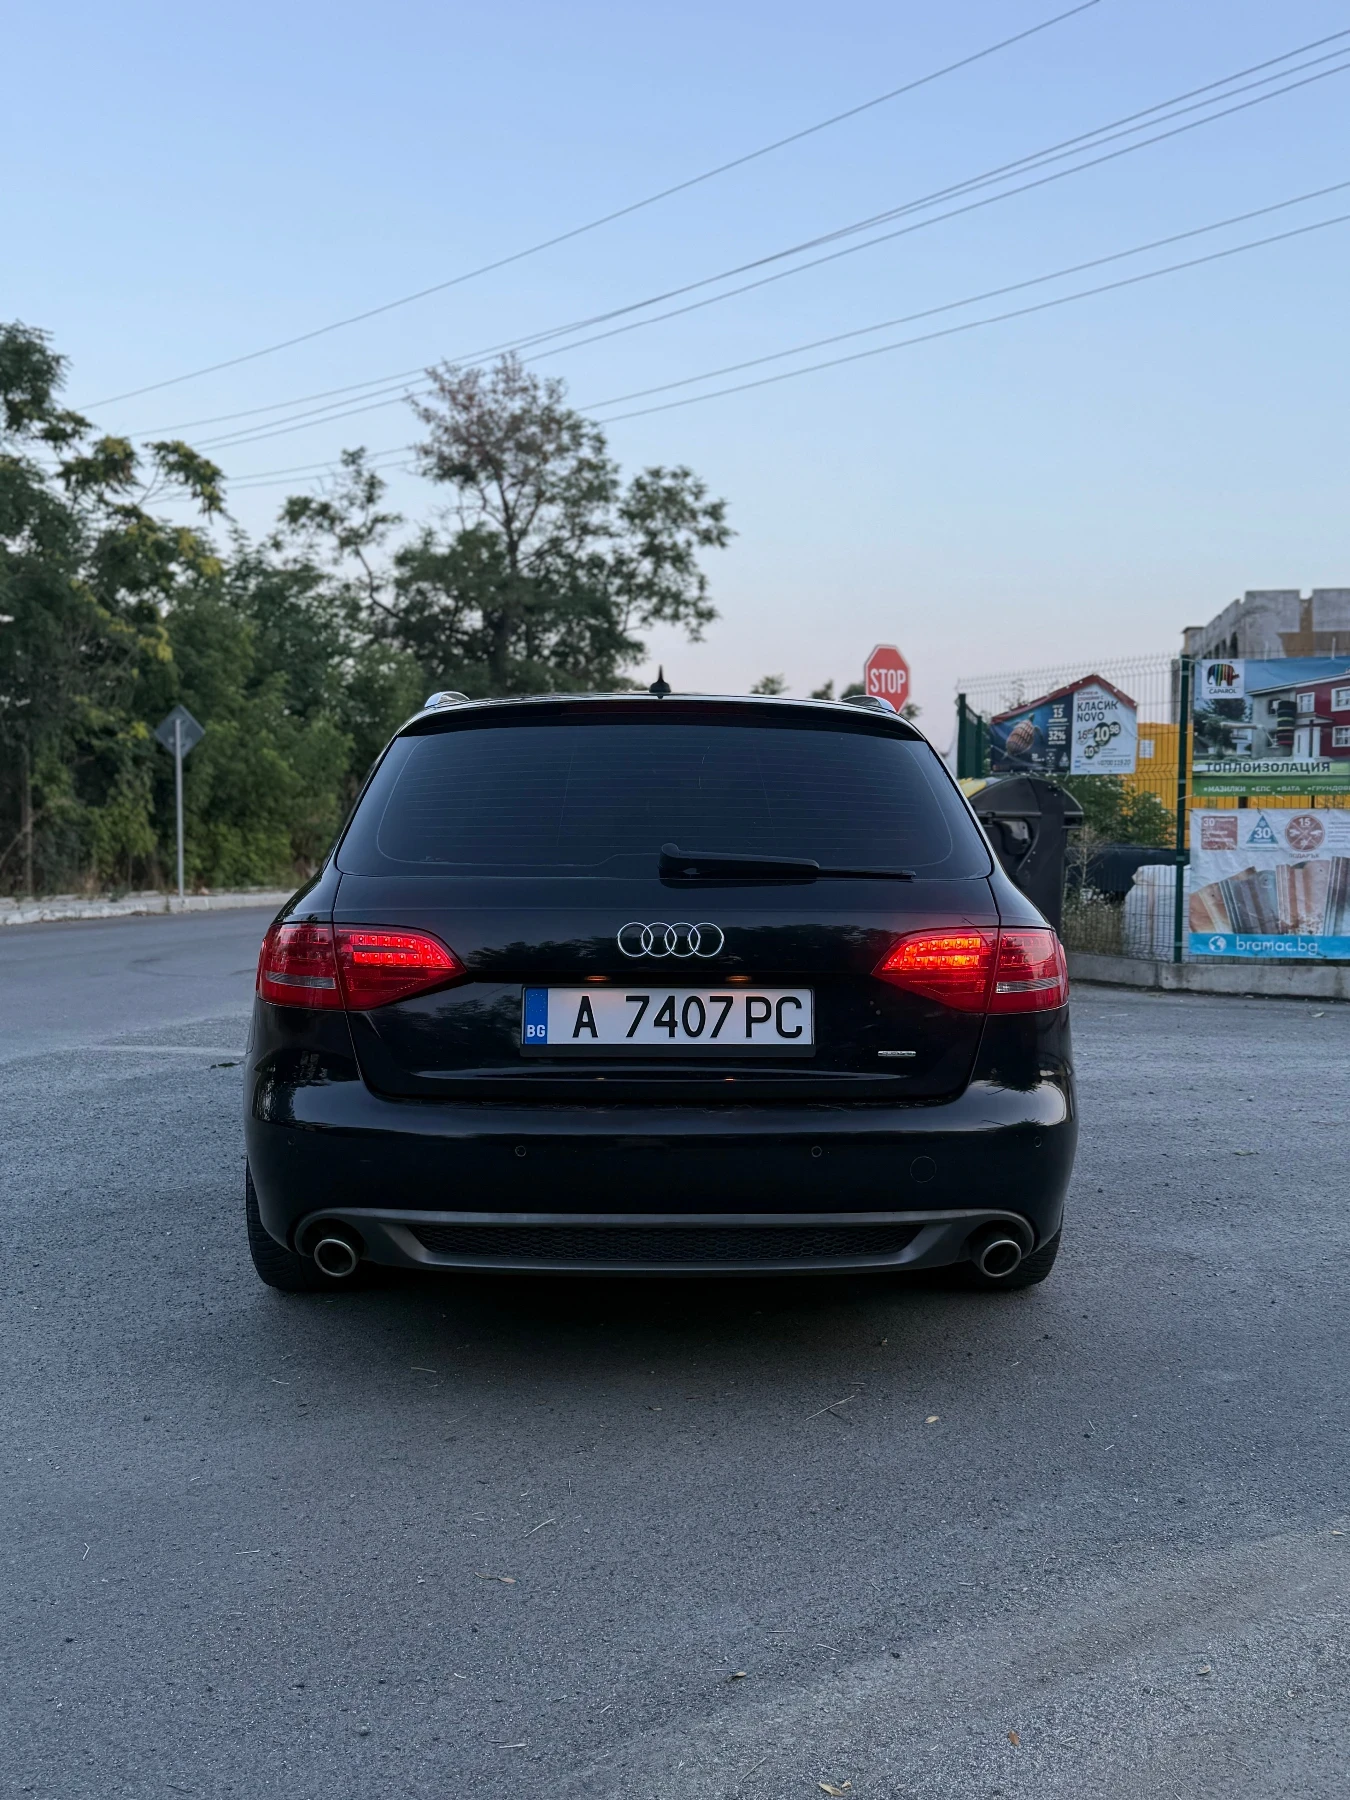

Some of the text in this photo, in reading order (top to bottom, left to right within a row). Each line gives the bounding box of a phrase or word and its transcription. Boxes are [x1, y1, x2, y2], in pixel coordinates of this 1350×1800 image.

[870, 668, 906, 694] STOP
[1077, 700, 1119, 712] КЛАСИК
[1053, 708, 1064, 718] 15
[1077, 711, 1105, 722] NOVO
[1048, 731, 1067, 740] 32%
[1094, 726, 1110, 742] 10
[1205, 762, 1330, 774] ТОПЛОИЗОЛАЦИЯ
[1203, 817, 1215, 827] 30
[1299, 817, 1311, 827] 15
[1254, 827, 1272, 839] 30
[1236, 936, 1318, 954] bramac.bg
[572, 995, 803, 1039] A 7407 PC
[526, 1024, 546, 1038] BG
